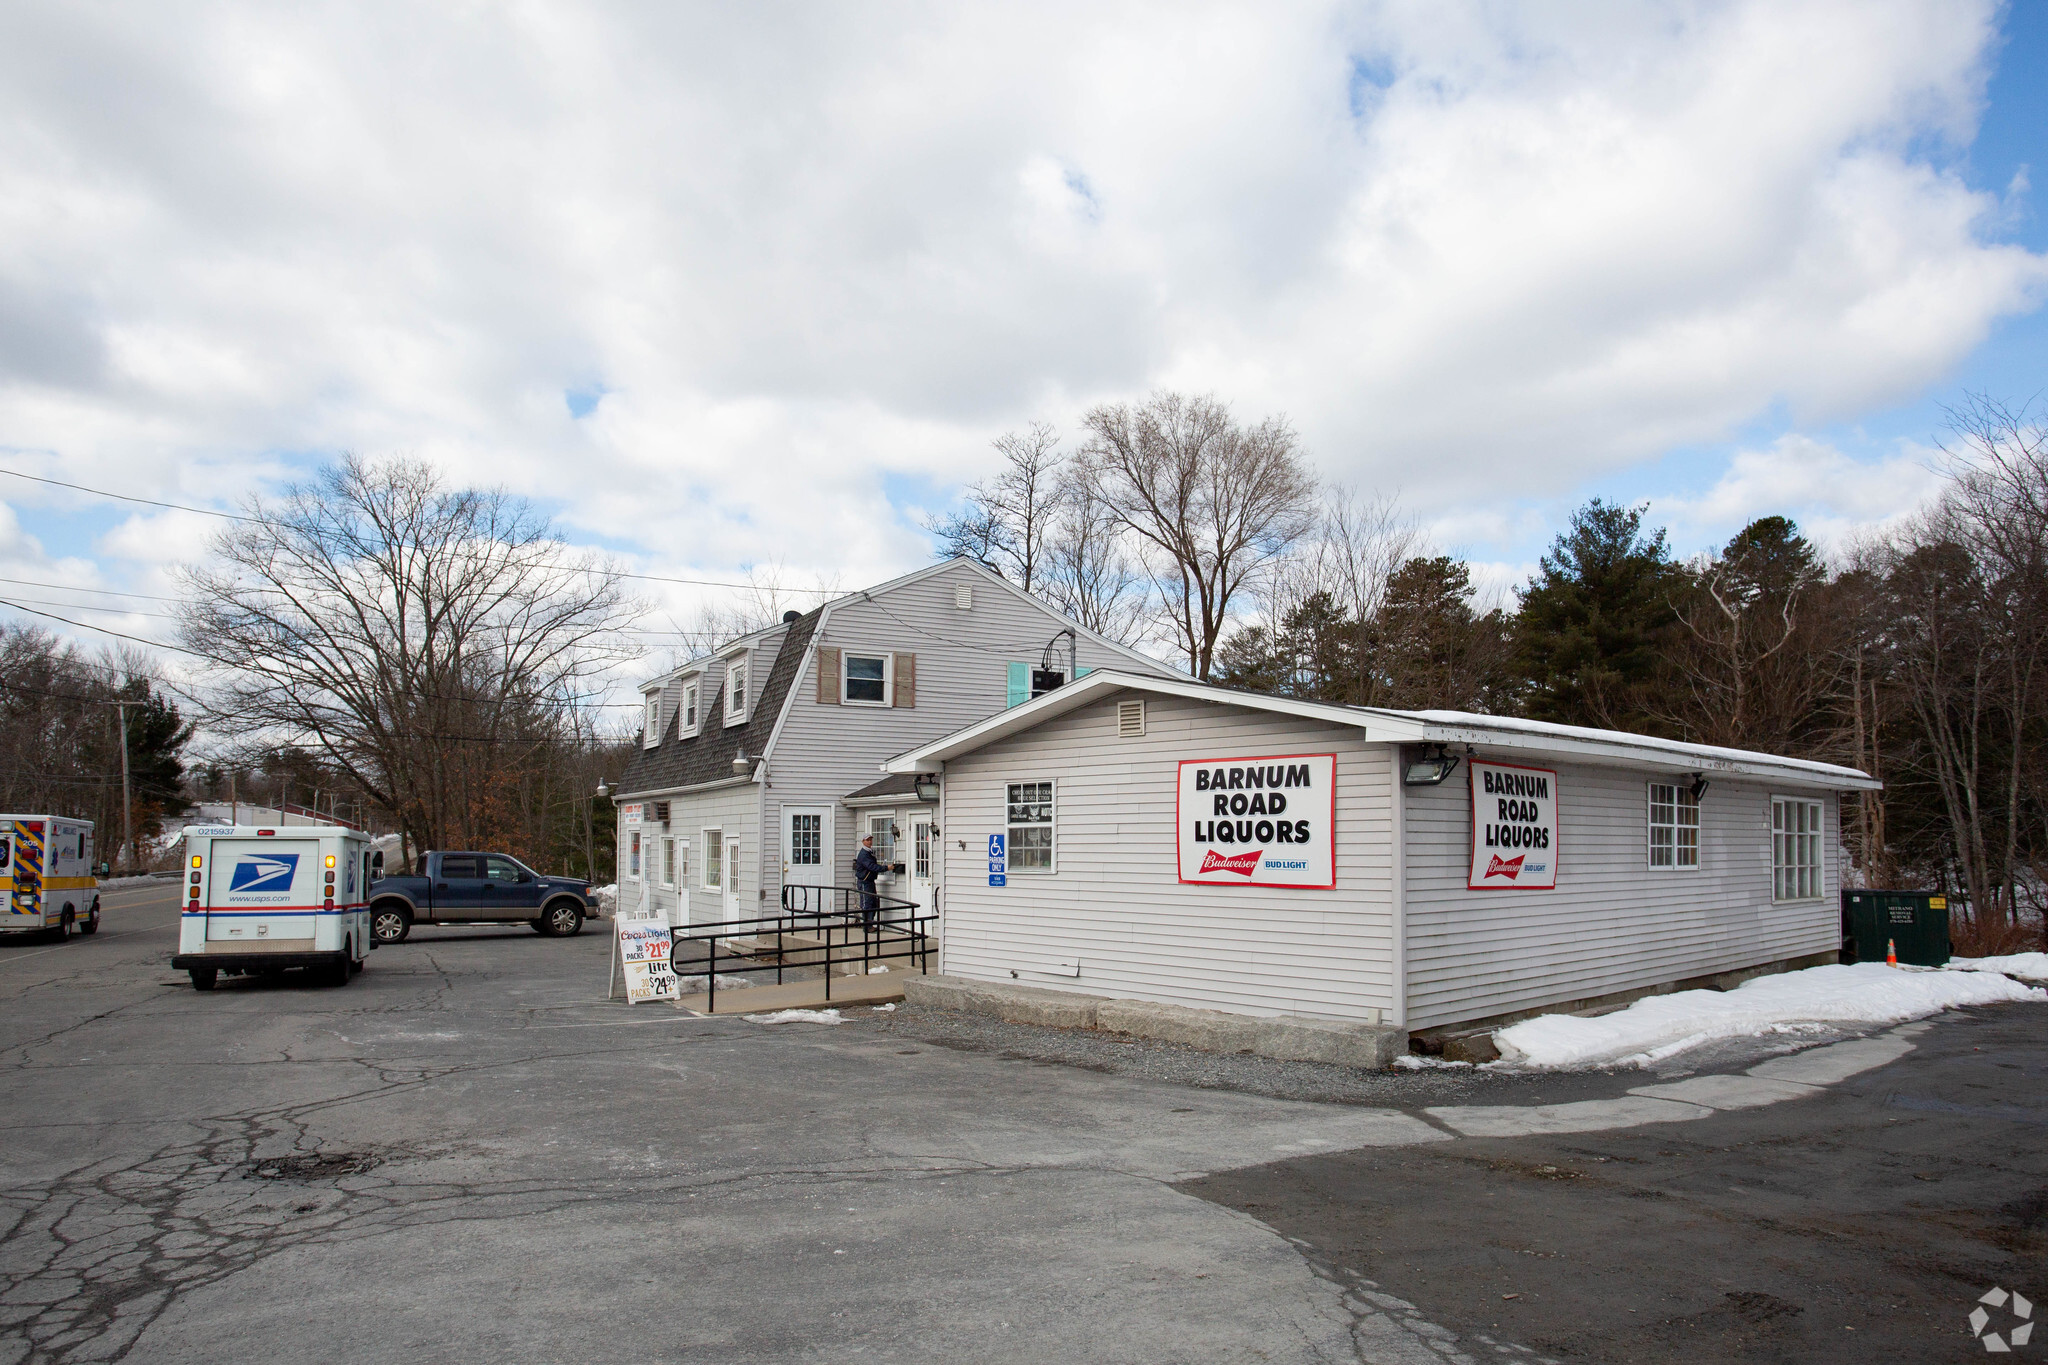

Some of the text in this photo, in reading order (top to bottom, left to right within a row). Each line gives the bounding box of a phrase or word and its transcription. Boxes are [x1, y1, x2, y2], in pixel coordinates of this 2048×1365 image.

[1196, 764, 1311, 791] BARNUM
[1483, 771, 1548, 798] BARNUM
[1213, 792, 1287, 816] ROAD
[1498, 798, 1538, 822] ROAD
[198, 828, 235, 836] 0215937
[1195, 820, 1310, 844] LIQUORS
[1486, 824, 1549, 849] LIQUORS
[23, 839, 38, 847] 205
[1203, 855, 1257, 869] Budweiser
[1283, 861, 1307, 869] LIGHT
[1489, 859, 1521, 873] Budweiser
[229, 895, 291, 903] www.usps.com
[621, 930, 670, 940] Coors LIGHT
[635, 944, 643, 952] 30
[627, 952, 644, 960] PACKS
[648, 962, 667, 974] Lite
[641, 978, 649, 988] 30
[631, 988, 650, 998] PACKS
